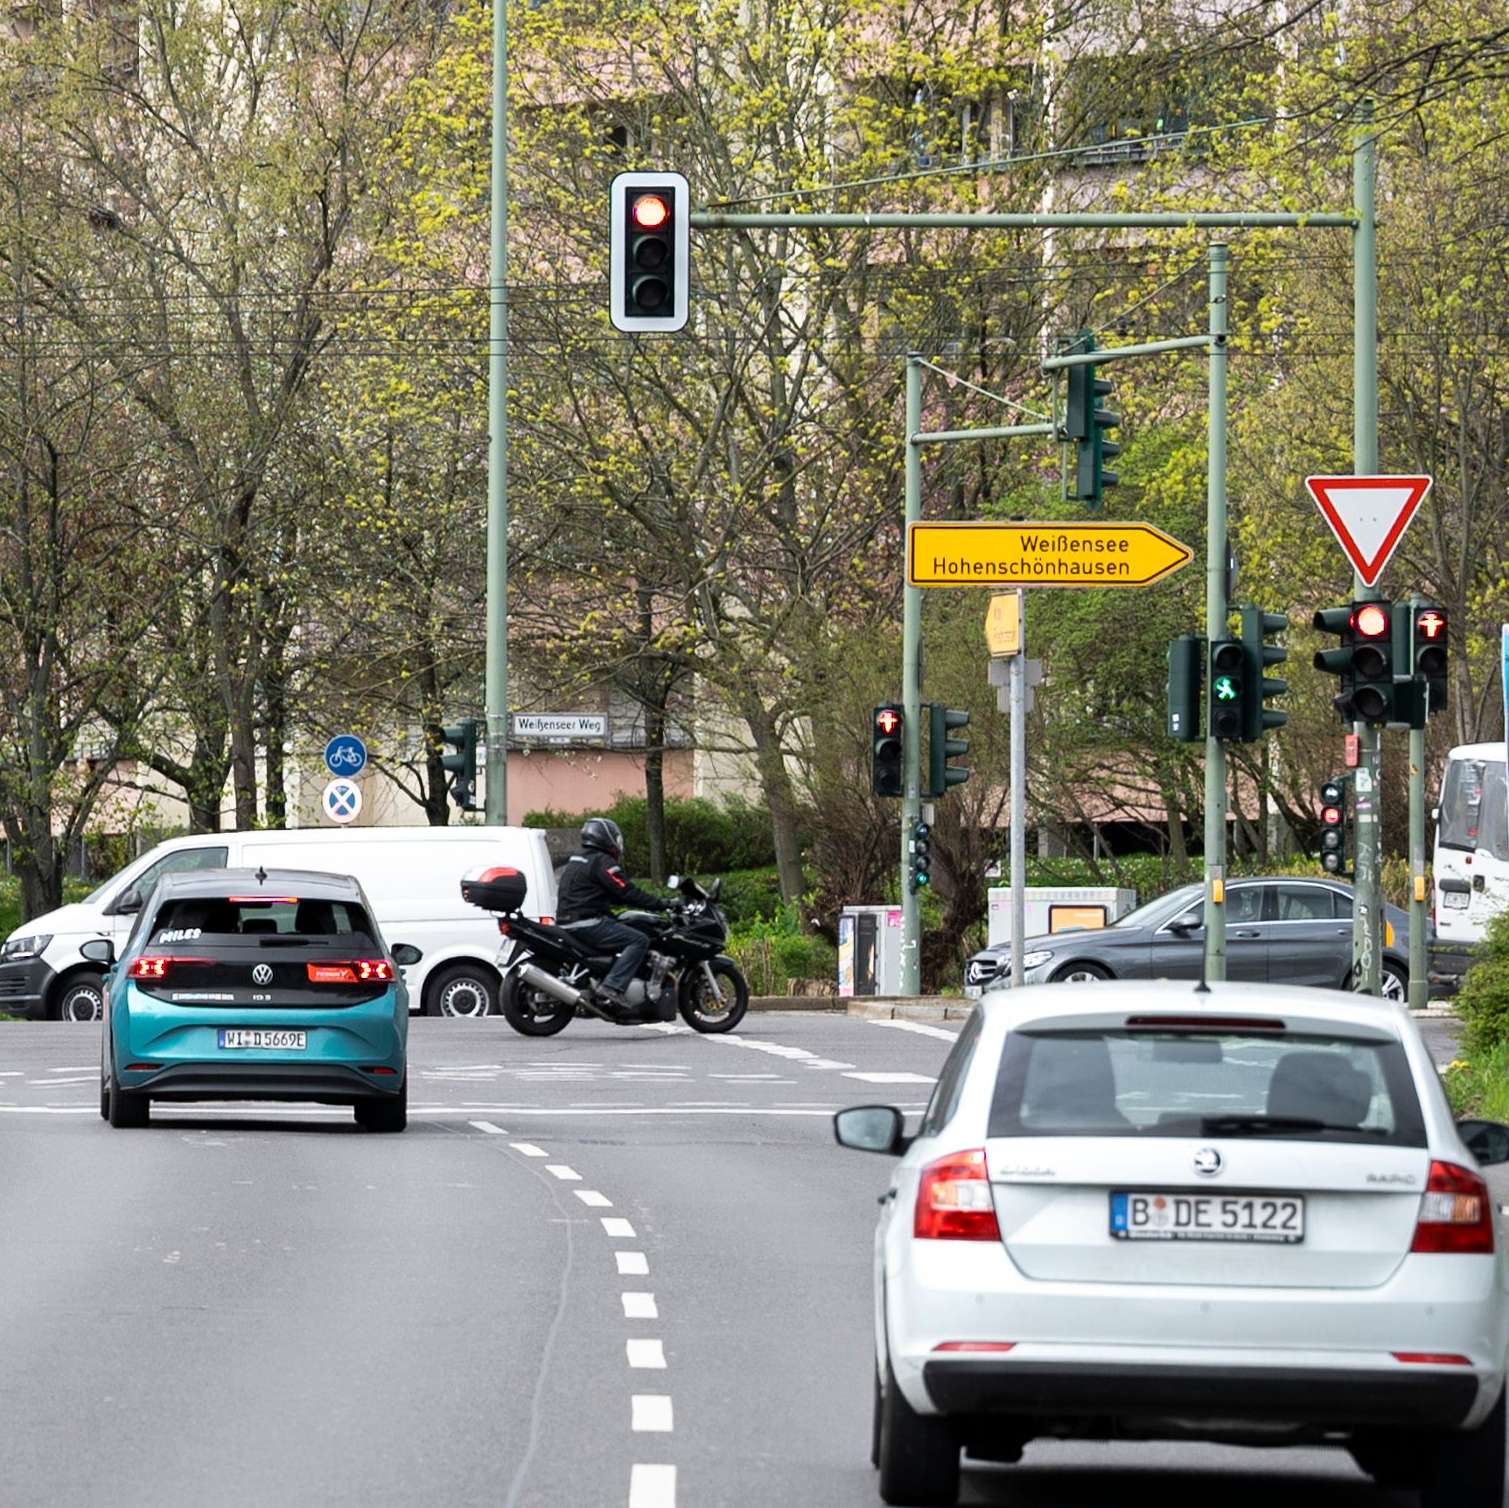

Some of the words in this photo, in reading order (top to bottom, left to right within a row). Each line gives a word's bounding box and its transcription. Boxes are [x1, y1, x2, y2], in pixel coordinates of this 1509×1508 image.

[1020, 535, 1129, 553] Weißensee
[933, 557, 1130, 575] Hohenschönhausen
[518, 718, 576, 731] Weißenseer
[579, 718, 601, 732] Weg
[159, 928, 202, 944] MILES
[227, 1032, 242, 1046] WI
[1132, 1198, 1150, 1226] B
[1173, 1199, 1213, 1228] DE
[1220, 1200, 1298, 1231] 5122
